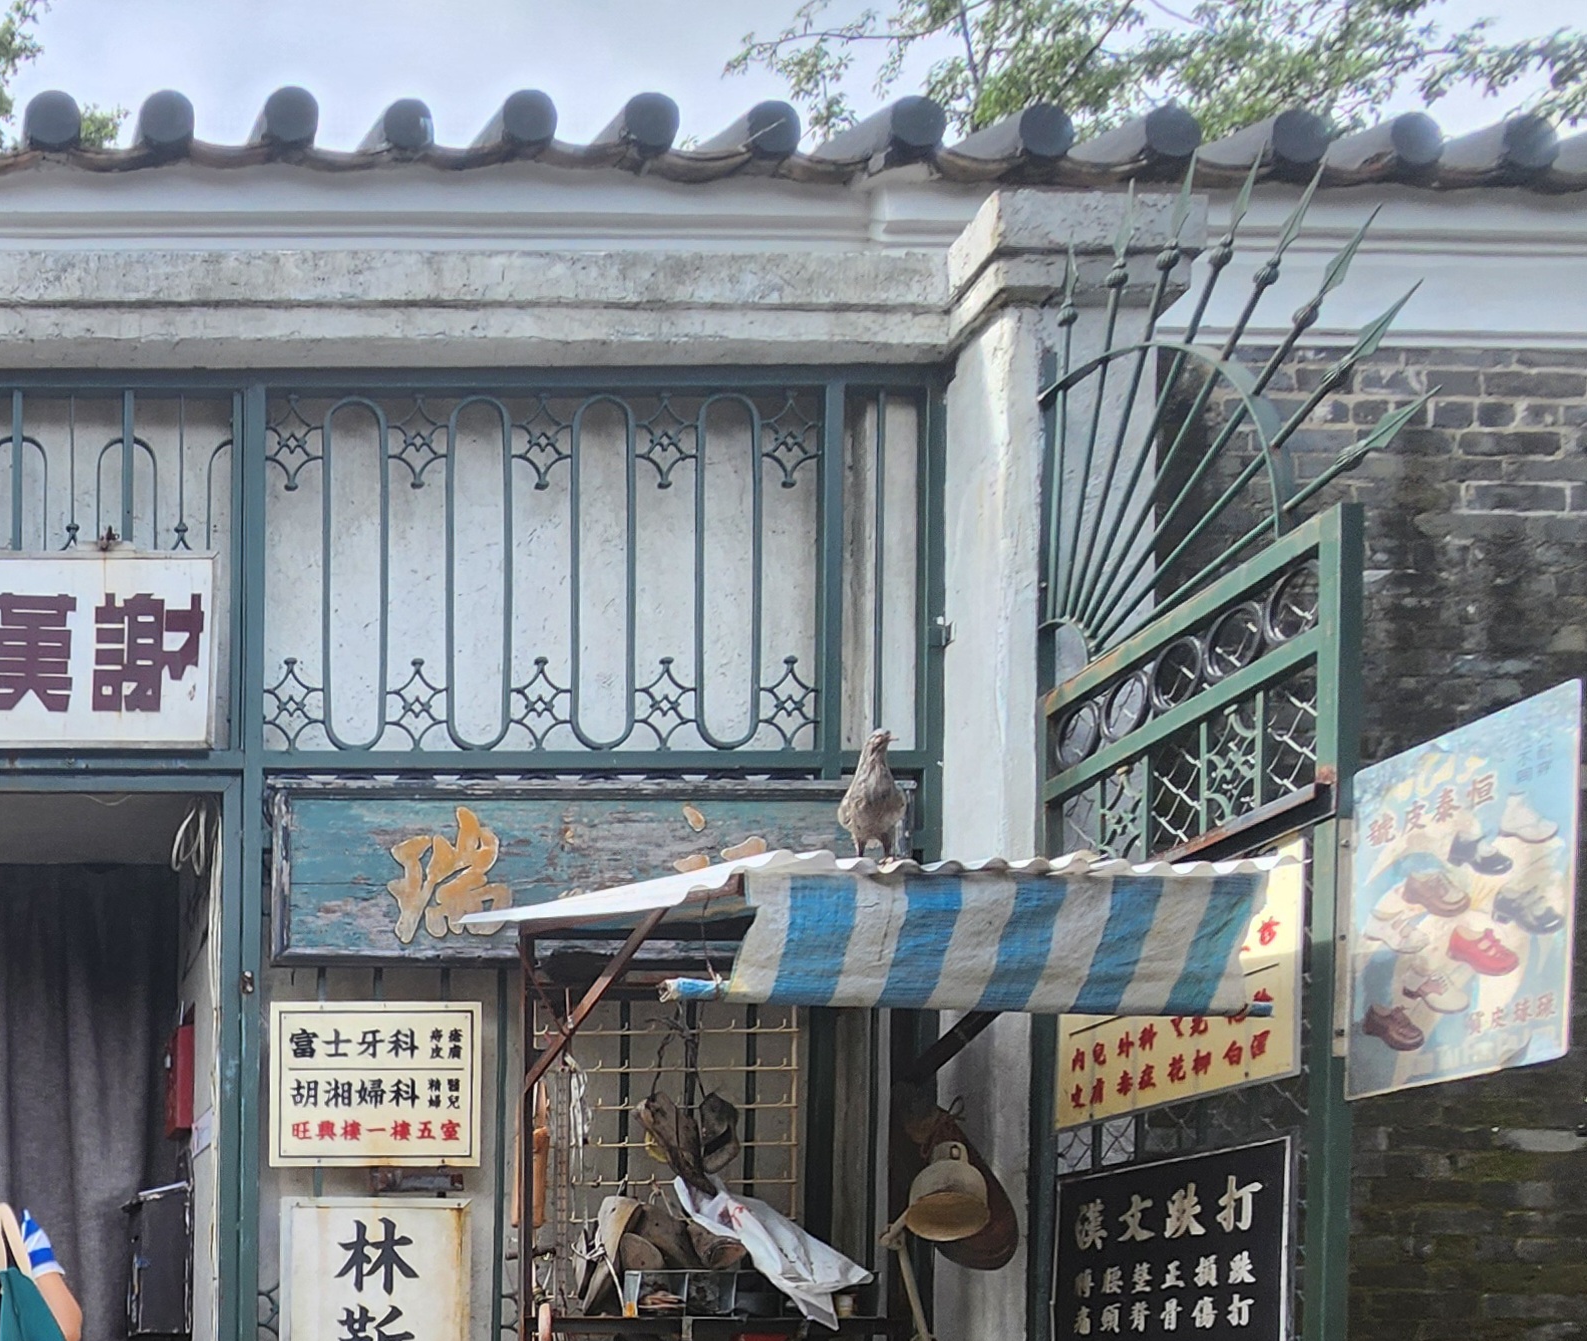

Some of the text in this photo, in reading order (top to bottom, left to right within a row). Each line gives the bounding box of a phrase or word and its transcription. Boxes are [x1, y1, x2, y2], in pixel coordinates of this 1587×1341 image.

[289, 1028, 420, 1060] 富士牙科
[290, 1077, 421, 1110] 胡湘婦科
[291, 1118, 462, 1142] 旺興樓一樓五室
[1074, 1175, 1263, 1251] 漢文跌打
